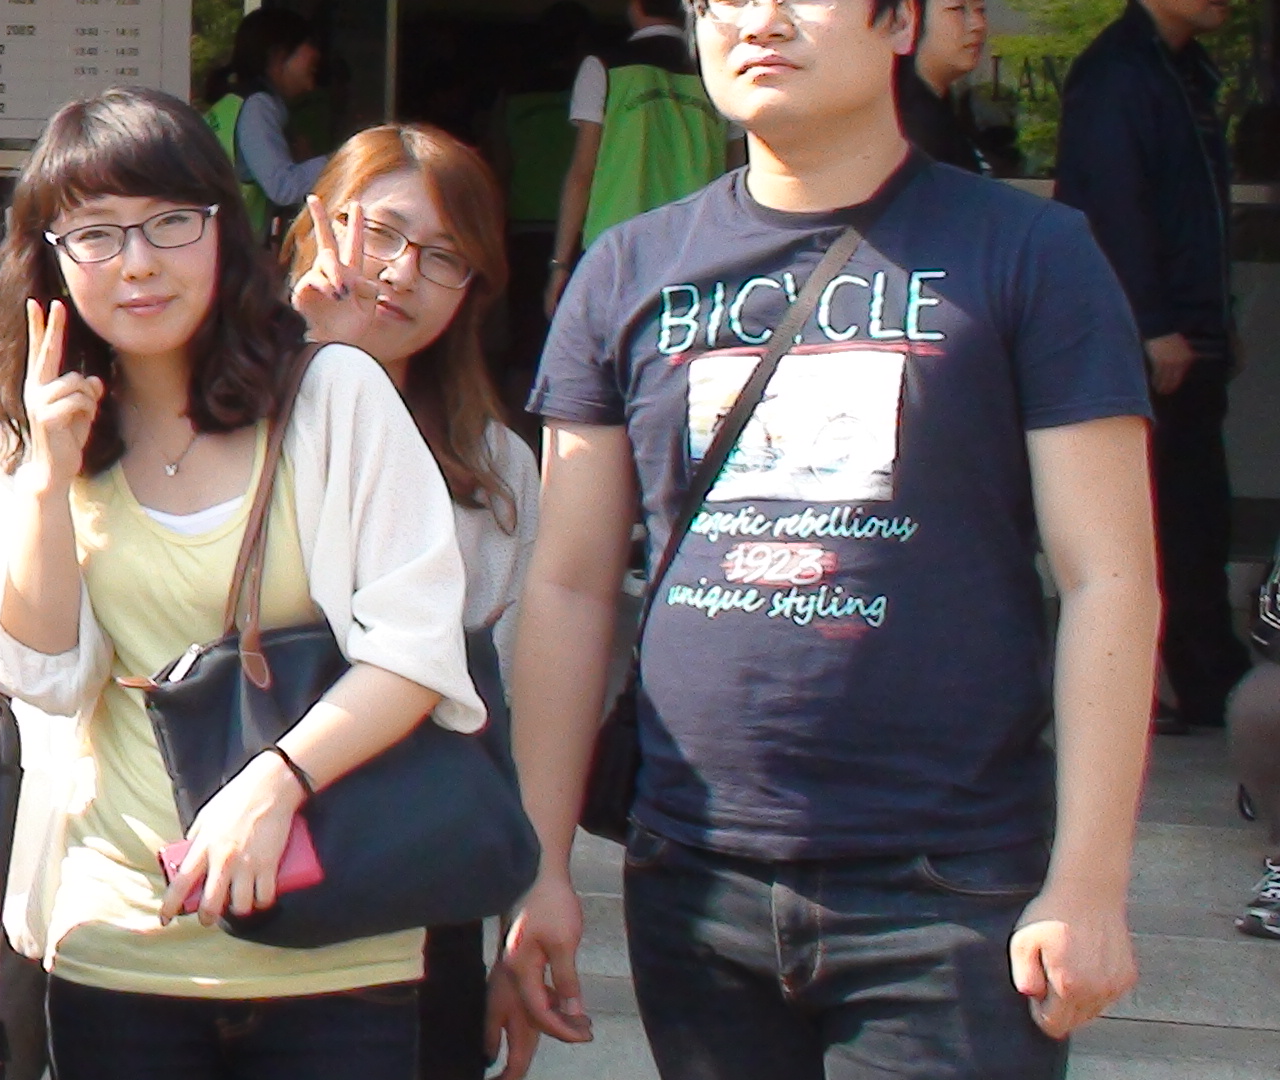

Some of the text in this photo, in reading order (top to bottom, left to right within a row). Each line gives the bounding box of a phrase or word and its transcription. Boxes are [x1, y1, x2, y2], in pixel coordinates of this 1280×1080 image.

[658, 269, 946, 354] BICCLE
[773, 506, 919, 542] rebellious
[668, 577, 889, 628] unique styling
